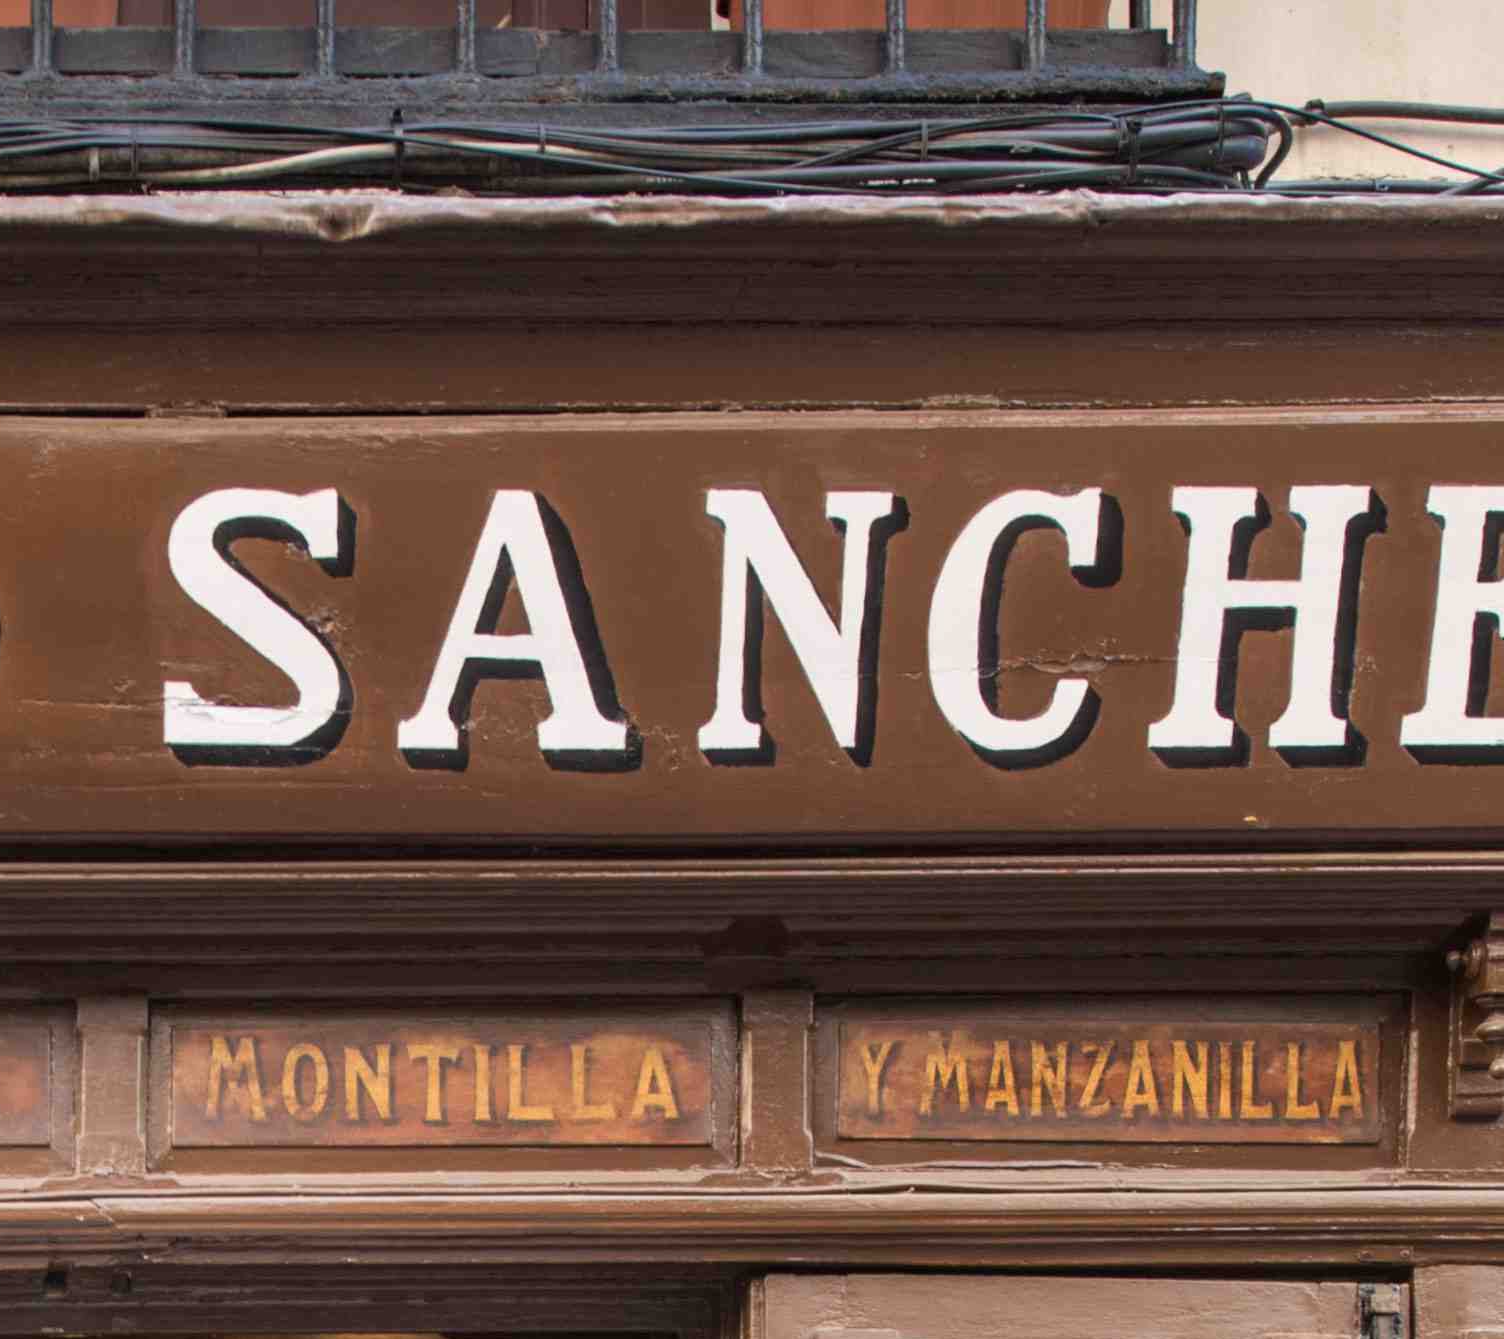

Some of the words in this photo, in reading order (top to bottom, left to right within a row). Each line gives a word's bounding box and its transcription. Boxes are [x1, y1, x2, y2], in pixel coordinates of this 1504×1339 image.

[202, 1034, 684, 1125] MONTILLA
[859, 1038, 896, 1120] Y
[918, 1032, 1366, 1121] MANZANILLA
